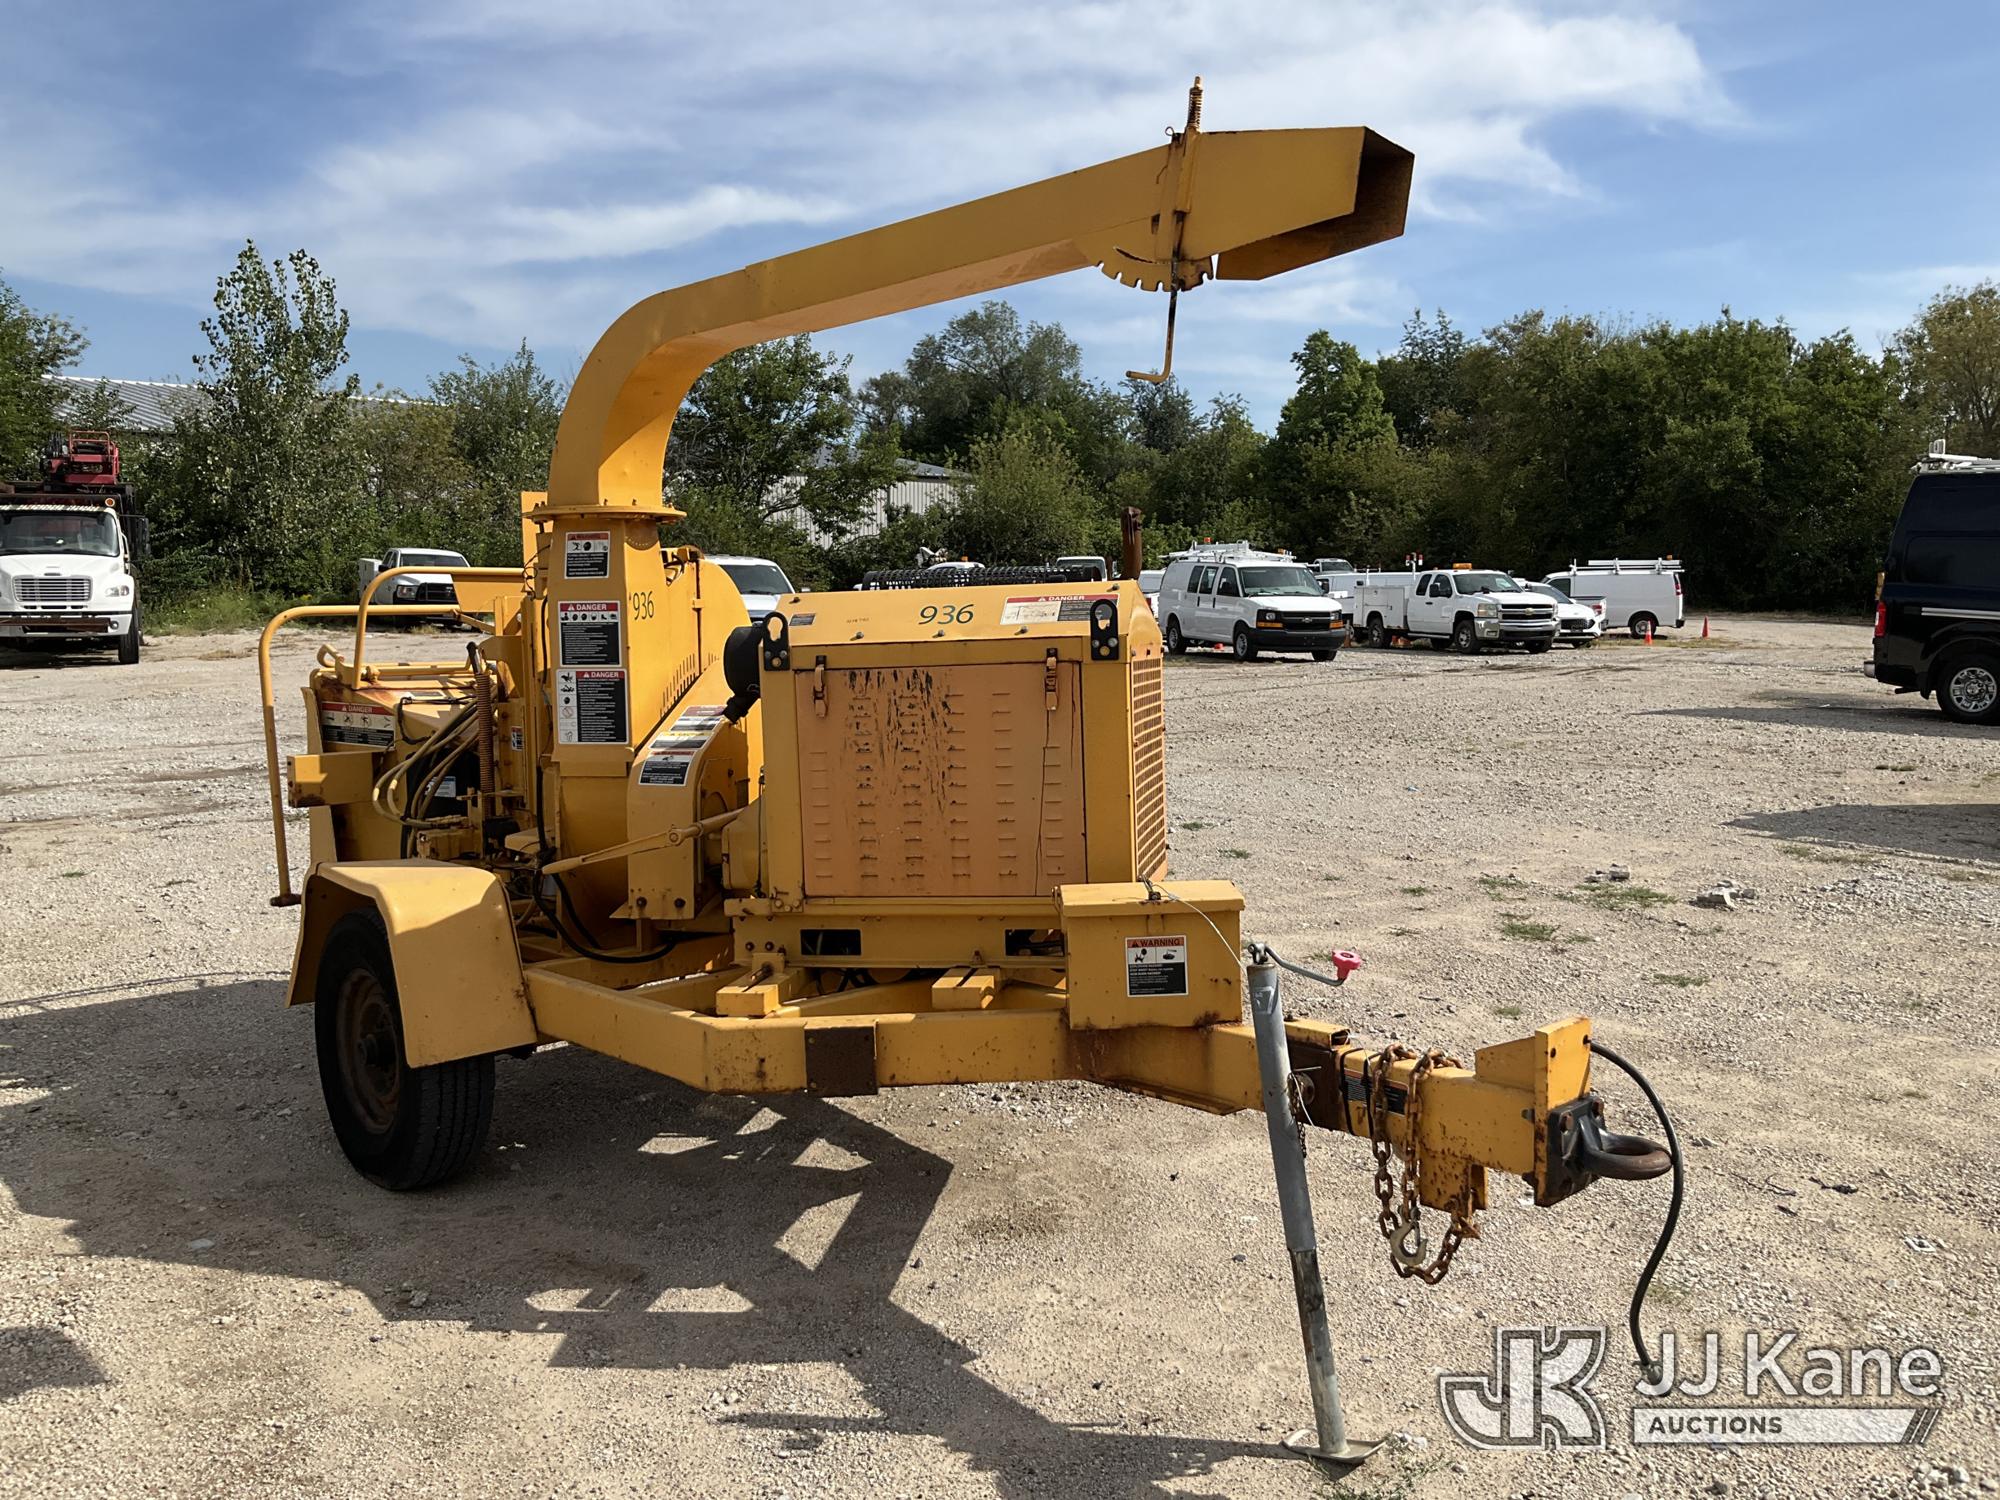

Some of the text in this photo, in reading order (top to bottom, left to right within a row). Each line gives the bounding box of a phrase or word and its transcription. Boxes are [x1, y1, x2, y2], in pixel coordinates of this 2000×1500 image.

[576, 603, 607, 611] DANGER
[632, 590, 655, 620] 936
[918, 603, 975, 625] 936
[348, 705, 373, 713] DANGER
[1140, 938, 1180, 947] WARNING
